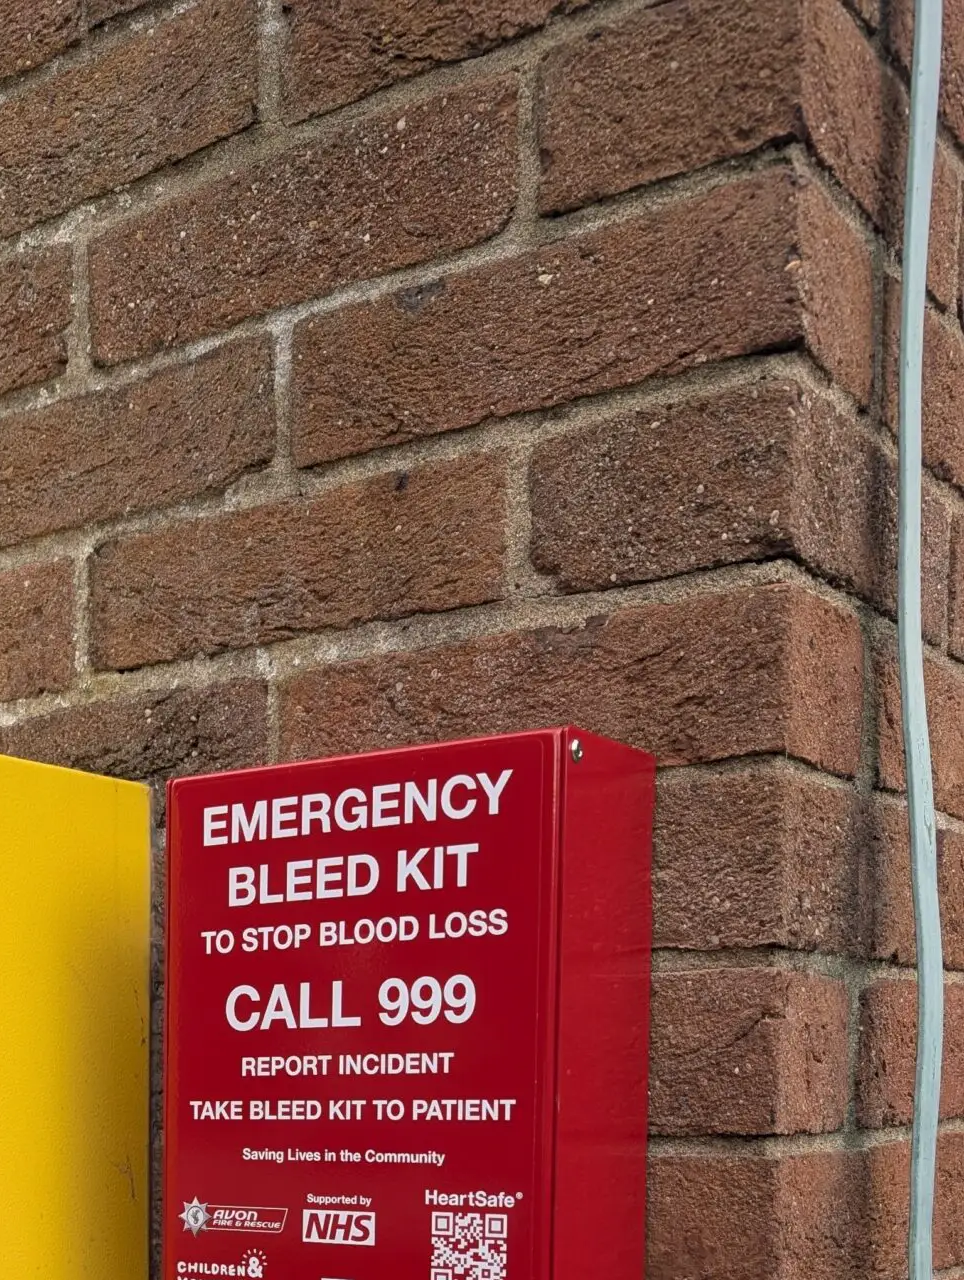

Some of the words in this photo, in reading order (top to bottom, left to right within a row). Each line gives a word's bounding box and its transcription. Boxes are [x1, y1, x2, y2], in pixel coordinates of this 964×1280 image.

[203, 769, 513, 847] EMERGENCY
[228, 853, 379, 907] BLEED
[396, 843, 479, 892] KIT
[201, 929, 234, 954] TO
[242, 923, 311, 952] STOP
[319, 915, 419, 947] BLOOD
[429, 909, 508, 939] LOSS
[225, 980, 361, 1032] CALL
[378, 974, 476, 1026] 999
[241, 1055, 332, 1076] REPORT
[338, 1052, 454, 1075] INCIDENT
[190, 1100, 243, 1120] TAKE
[249, 1100, 322, 1120] BLEED
[328, 1100, 366, 1120] KIT
[372, 1099, 405, 1120] TO
[412, 1099, 516, 1121] PATIENT
[242, 1147, 284, 1164] Saving
[287, 1148, 321, 1162] Lives
[324, 1149, 336, 1162] in
[339, 1149, 361, 1163] the
[364, 1149, 445, 1166] Community
[306, 1193, 357, 1205] Supported
[359, 1196, 372, 1207] by
[213, 1209, 258, 1221] AVON
[244, 1221, 281, 1229] RESCUE
[305, 1212, 372, 1242] NHS
[177, 1261, 245, 1276] CHILDREN
